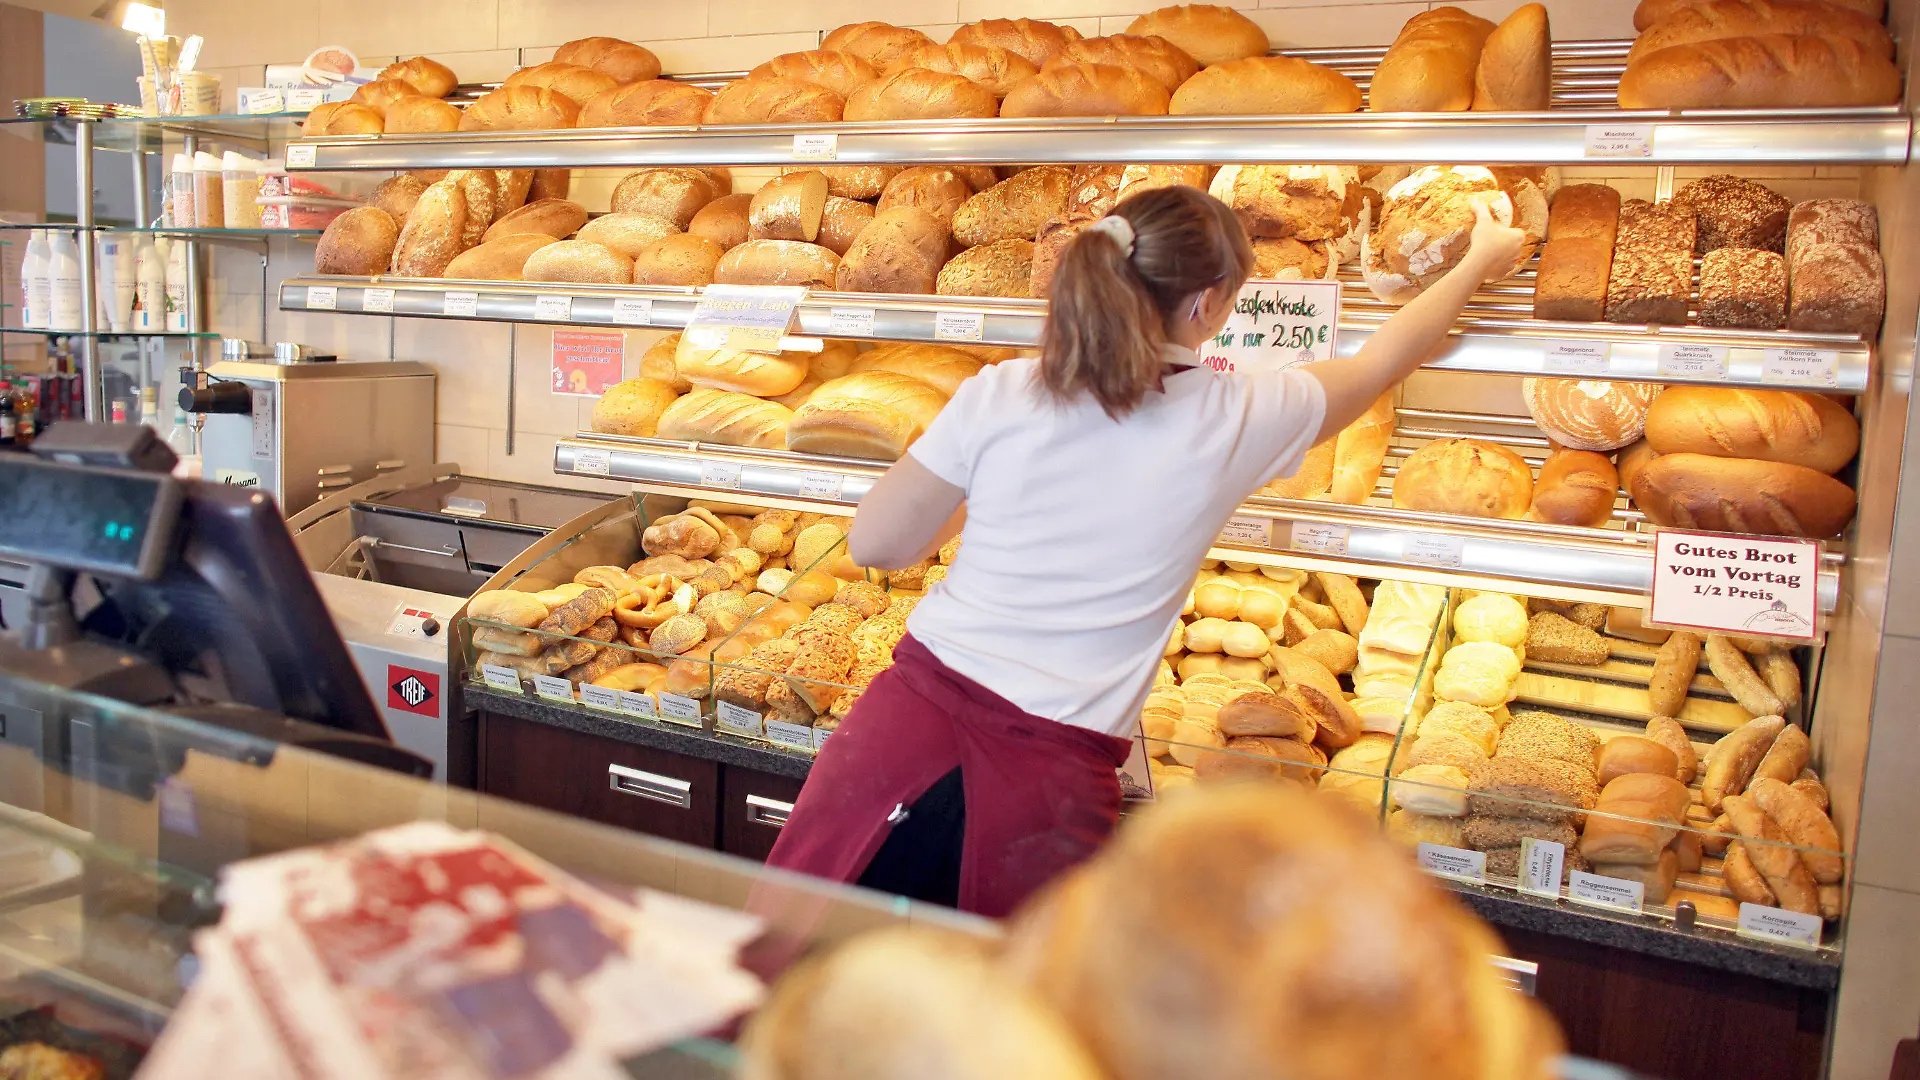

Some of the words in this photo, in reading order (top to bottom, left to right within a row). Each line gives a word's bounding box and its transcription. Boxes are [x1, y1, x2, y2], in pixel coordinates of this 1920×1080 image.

[1243, 333, 1265, 348] nur
[1318, 325, 1329, 343] €
[572, 344, 589, 352] wird
[1783, 349, 1817, 357] Steinmetz
[1202, 356, 1228, 371] 1000
[1674, 542, 1737, 560] Gutes
[1744, 548, 1798, 565] Brot
[1668, 565, 1716, 580] vom
[1723, 566, 1801, 588] Vortag
[1693, 584, 1721, 597] 1/2
[1727, 586, 1773, 601] Preis
[400, 676, 426, 706] TREIF
[1580, 879, 1631, 894] Roggensemmel
[1761, 914, 1797, 926] Kornspitz
